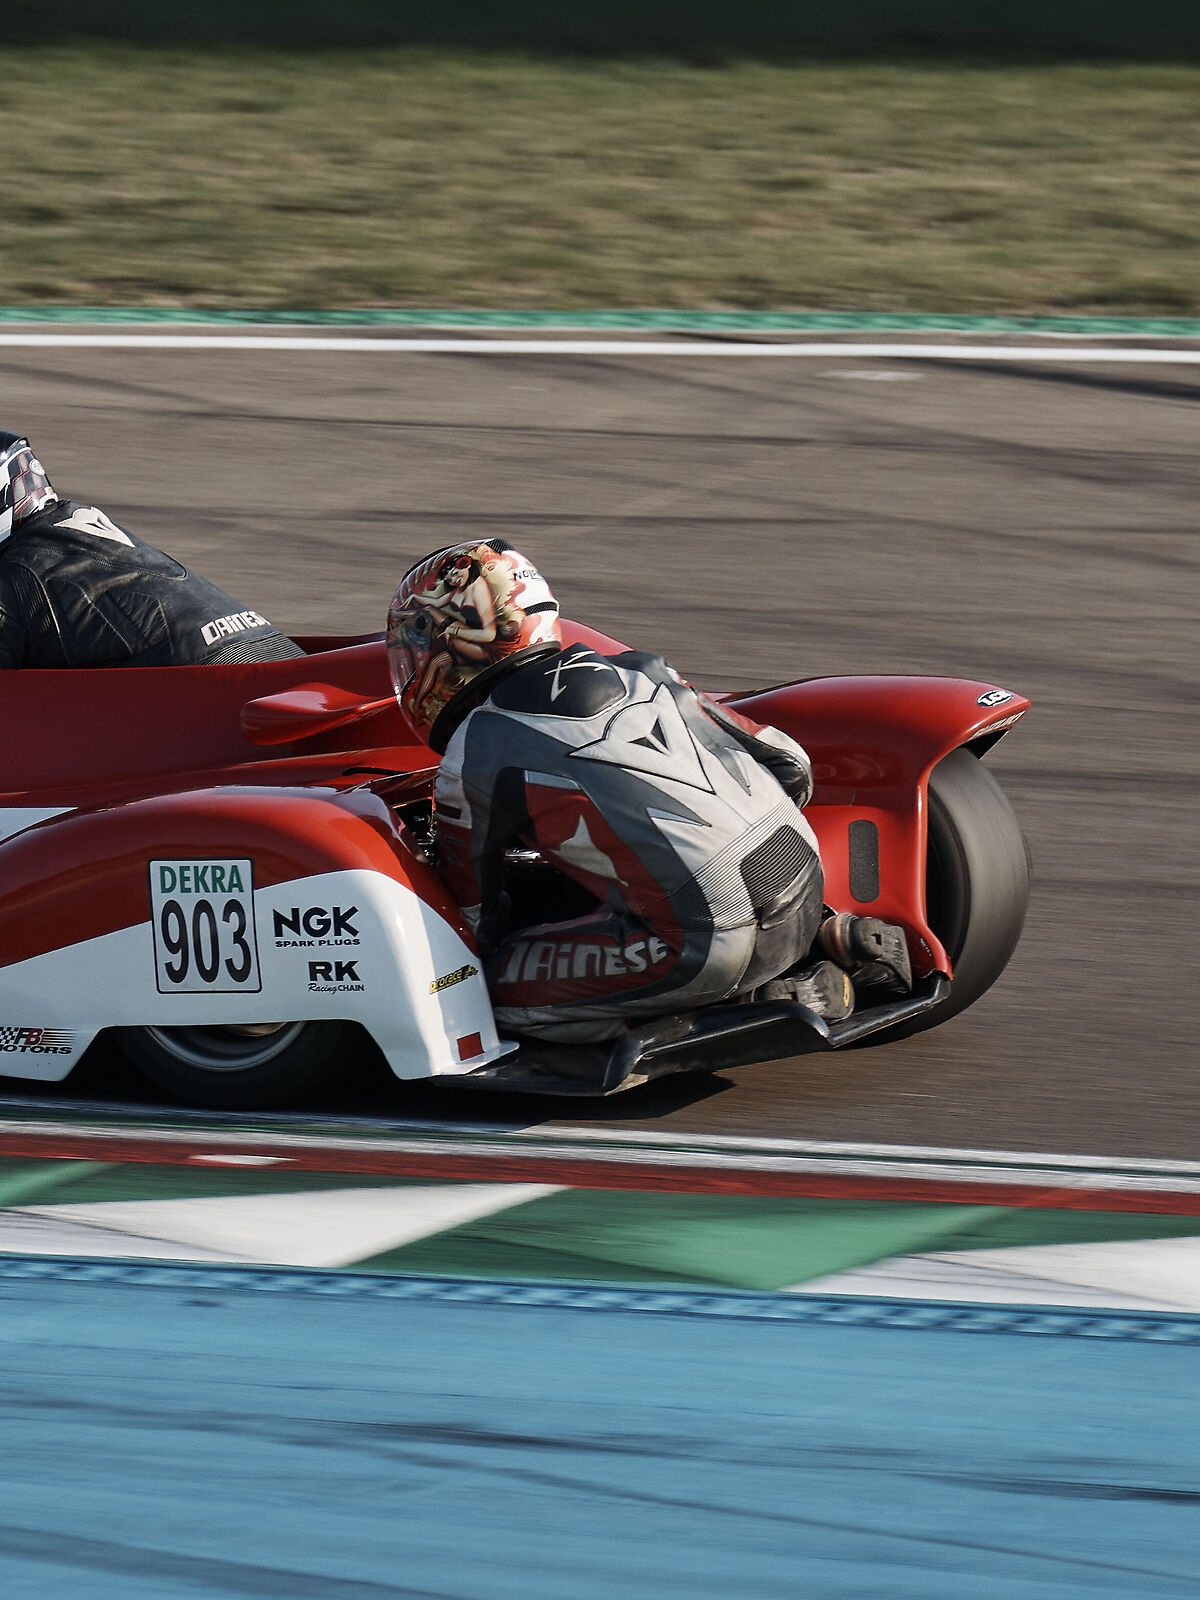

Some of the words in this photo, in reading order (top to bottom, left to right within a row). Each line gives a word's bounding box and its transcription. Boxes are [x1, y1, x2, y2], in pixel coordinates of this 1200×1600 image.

[159, 864, 245, 893] DEKRA
[273, 906, 360, 937] NGK
[161, 898, 252, 984] 903
[275, 940, 315, 948] SPARK
[319, 938, 361, 947] PLUGS
[308, 960, 361, 981] RK
[308, 982, 337, 995] Racing
[337, 984, 365, 992] CHAIN
